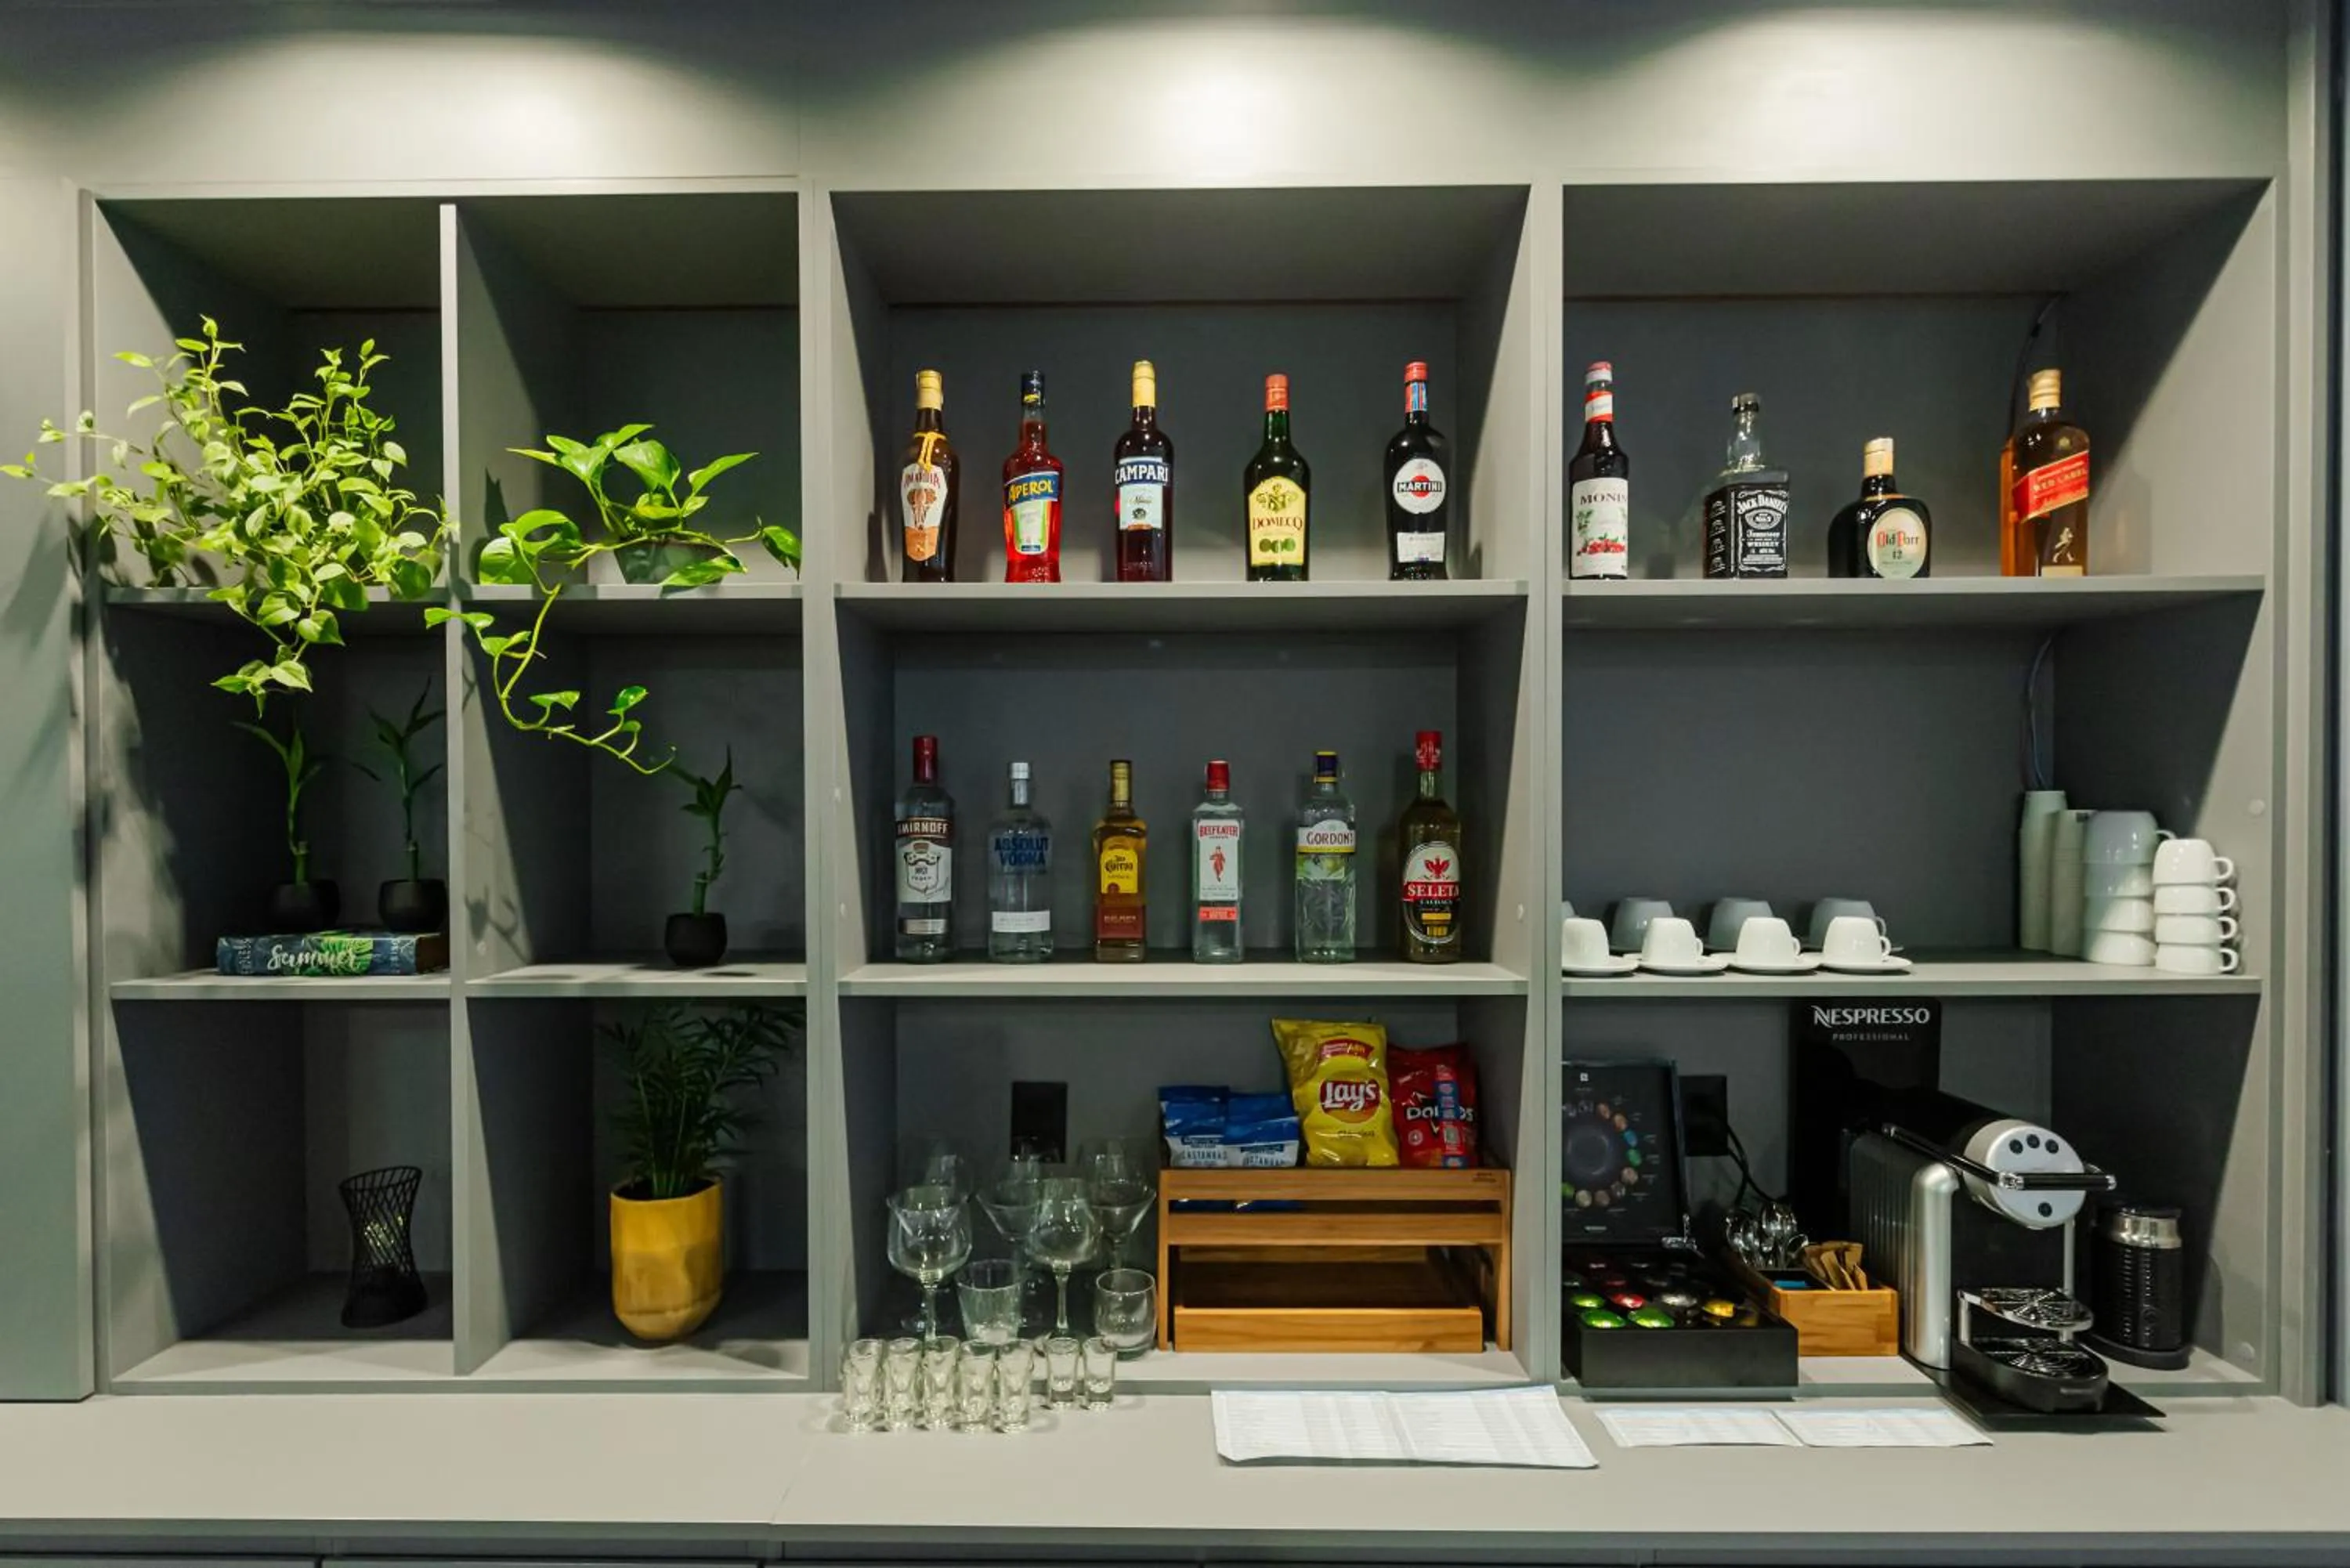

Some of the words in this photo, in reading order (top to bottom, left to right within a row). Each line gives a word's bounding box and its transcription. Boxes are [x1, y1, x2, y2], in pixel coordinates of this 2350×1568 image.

[1115, 464, 1168, 485] CAMPARI
[1010, 479, 1054, 501] APEROL
[1398, 481, 1441, 492] MARTINI
[1737, 498, 1758, 514] JACK
[1253, 516, 1303, 530] DOMECQ
[994, 836, 1049, 851] ABSOLUT
[999, 851, 1047, 866] VODKA
[1811, 1005, 1930, 1028] NESPRESSO
[1322, 1081, 1377, 1112] Lay's
